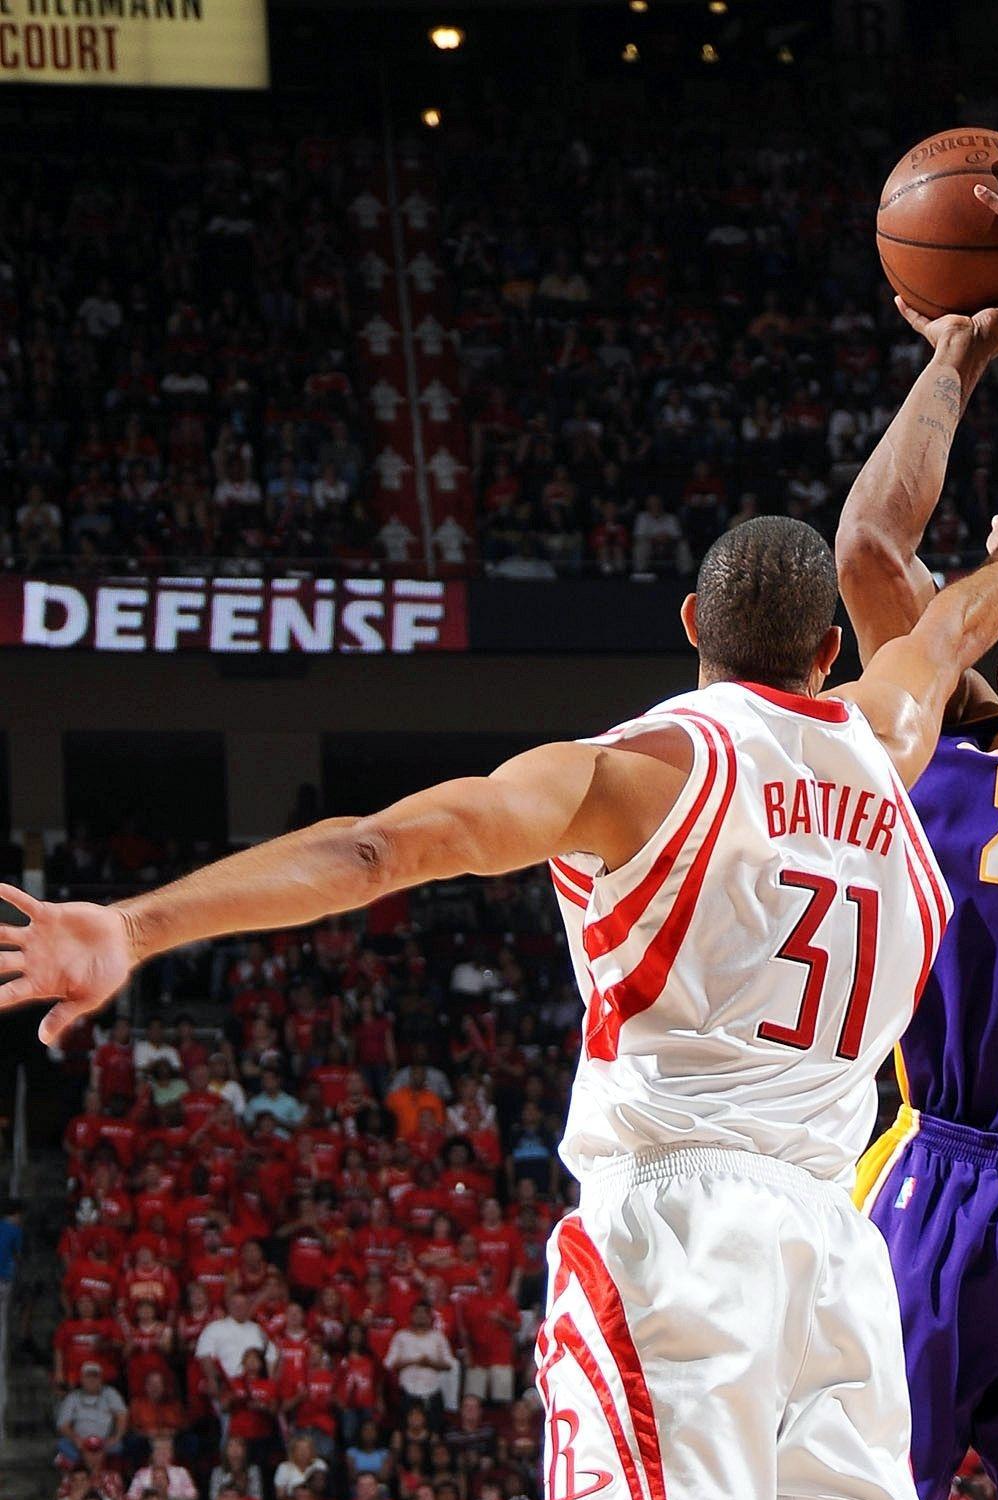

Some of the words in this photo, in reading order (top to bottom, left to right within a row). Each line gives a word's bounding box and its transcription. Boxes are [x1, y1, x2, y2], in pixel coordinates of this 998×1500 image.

[0, 22, 119, 71] COURT
[763, 778, 897, 857] BATIER
[756, 868, 881, 1064] 31
